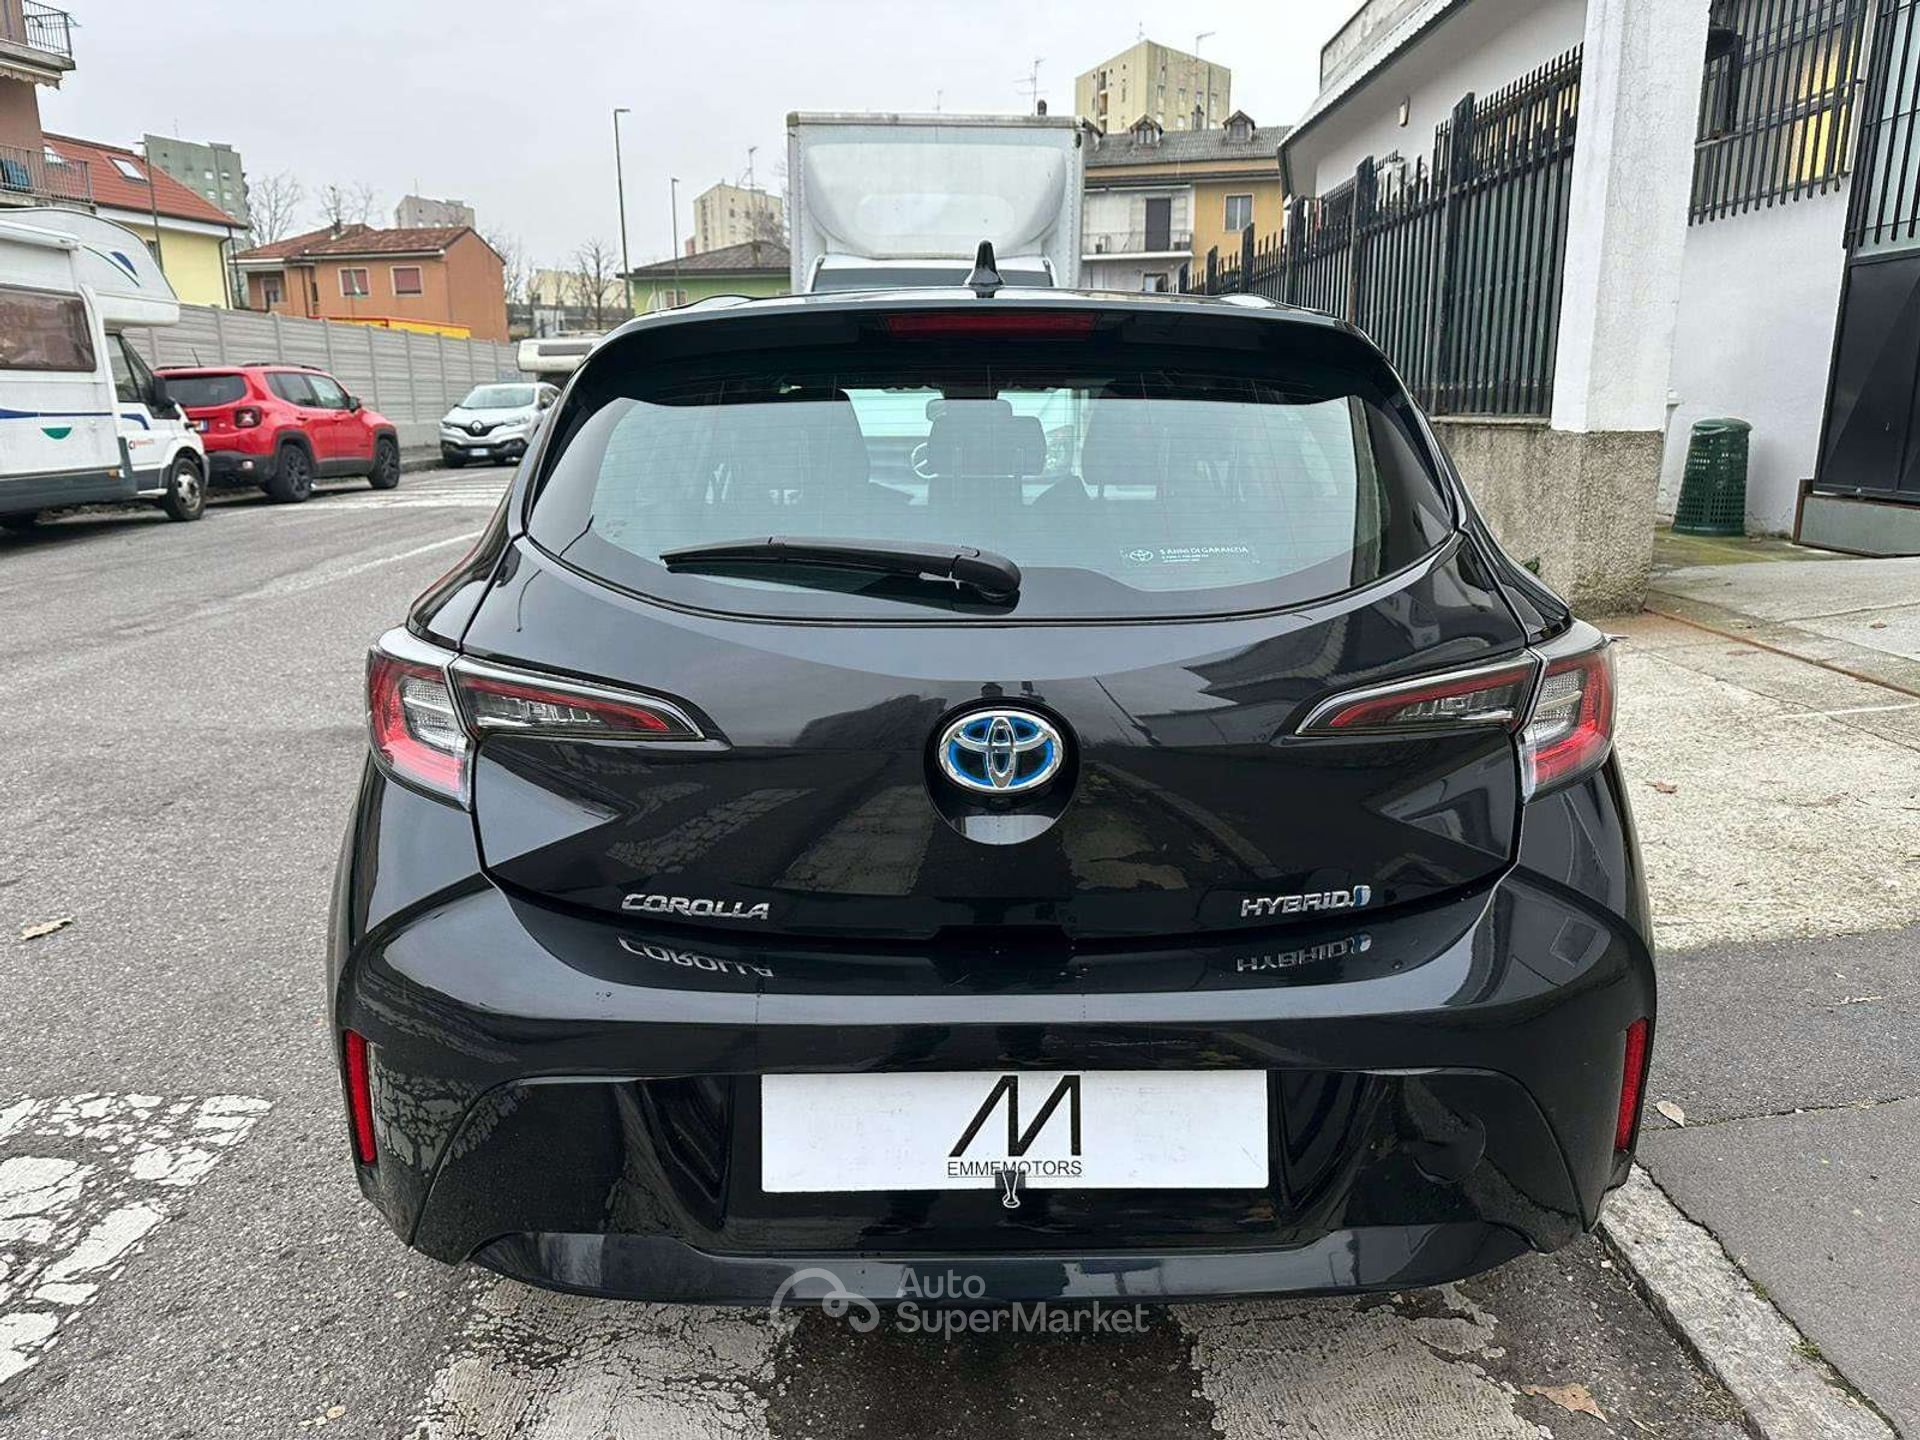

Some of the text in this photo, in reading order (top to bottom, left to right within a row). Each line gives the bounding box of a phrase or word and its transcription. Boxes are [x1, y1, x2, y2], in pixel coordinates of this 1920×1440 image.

[621, 893, 770, 921] COROLLA
[1240, 890, 1353, 918] HYBRID
[947, 1160, 1083, 1177] EMMEMOTORS
